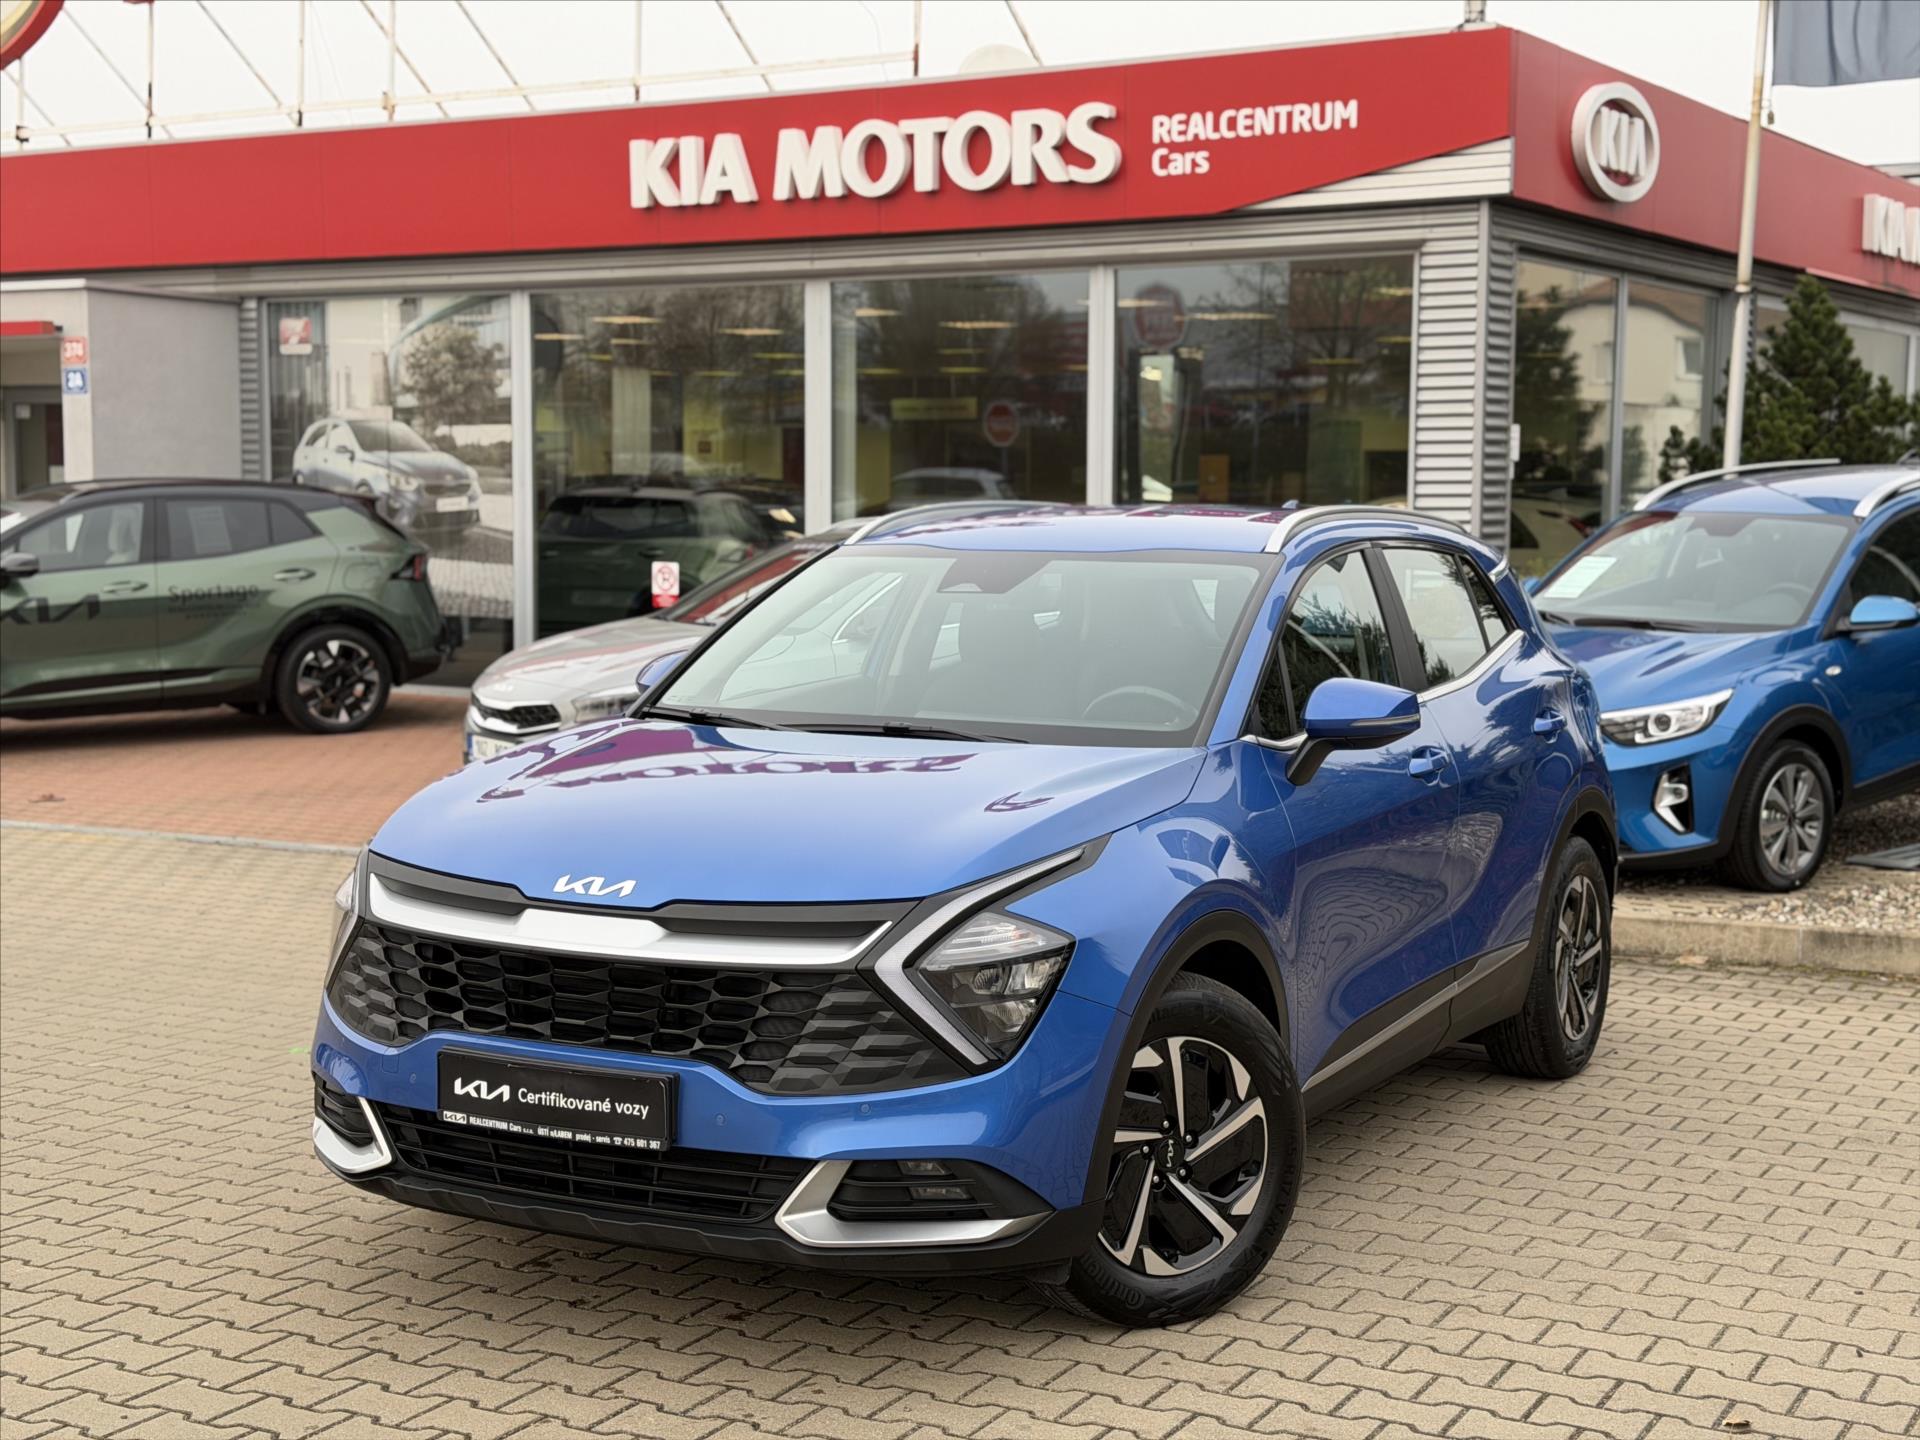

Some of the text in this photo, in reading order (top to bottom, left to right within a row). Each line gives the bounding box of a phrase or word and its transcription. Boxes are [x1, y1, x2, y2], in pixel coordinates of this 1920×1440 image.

[1151, 98, 1359, 144] REALCENTRUM
[1600, 105, 1647, 179] KIA
[629, 102, 1122, 209] KIA MOTORS
[1150, 147, 1210, 179] Cars
[552, 874, 637, 899] KIA
[454, 1077, 649, 1120] KIA Certifikované vozy
[469, 1116, 508, 1130] REALCENTRUM
[509, 1122, 522, 1132] Cars
[575, 1133, 592, 1143] prodej
[596, 1135, 611, 1144] servis
[623, 1137, 635, 1146] 475
